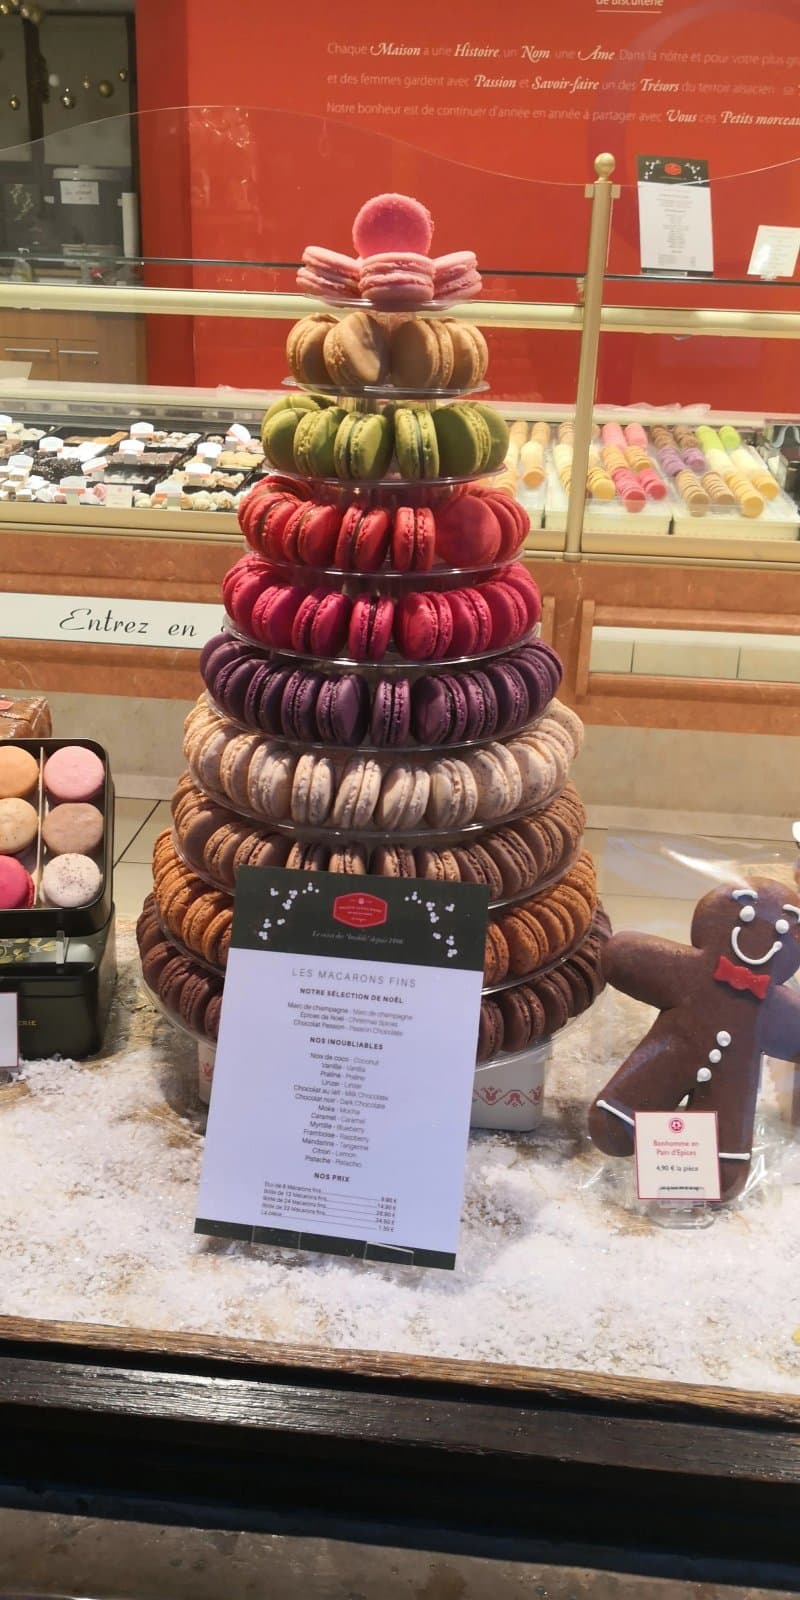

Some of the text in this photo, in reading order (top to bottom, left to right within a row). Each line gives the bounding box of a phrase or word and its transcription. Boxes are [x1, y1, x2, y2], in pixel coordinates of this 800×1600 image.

[327, 42, 367, 56] Chaque
[369, 42, 420, 56] Maison
[432, 47, 451, 56] une
[691, 52, 702, 62] et
[327, 74, 337, 84] et
[340, 73, 358, 84] des
[360, 73, 401, 85] femmes
[403, 75, 445, 88] gardent
[446, 78, 469, 87] avec
[474, 74, 517, 88] Passion
[520, 79, 529, 87] et
[531, 75, 599, 93] Savoir-faire
[640, 78, 679, 91] Trésors
[327, 102, 356, 113] Notre
[357, 102, 401, 114] bonheur
[403, 105, 419, 115] est
[421, 104, 435, 116] de
[437, 106, 487, 117] continuer
[532, 109, 546, 118] en
[592, 111, 636, 123] partager
[667, 109, 697, 122] Vous
[721, 111, 753, 124] Petits
[59, 607, 197, 637] Entrez en
[291, 968, 417, 988] LES MACARONS FINS
[299, 987, 325, 996] NOTRE
[327, 989, 370, 1000] SÉLECTION
[370, 994, 381, 1002] DE
[312, 1004, 349, 1015] champagne
[293, 1019, 320, 1027] Chocolat
[309, 1036, 384, 1050] NOS INOUBLIABLES
[353, 1057, 379, 1066] Coconut
[293, 1085, 321, 1093] Chocolat
[295, 1093, 322, 1101] Chocolat
[311, 1112, 337, 1120] Caramel
[303, 1128, 335, 1138] Framboise
[311, 1147, 357, 1158] Citron Lemon
[304, 1154, 331, 1164] Pistache
[314, 1171, 350, 1183] NOS PRIX
